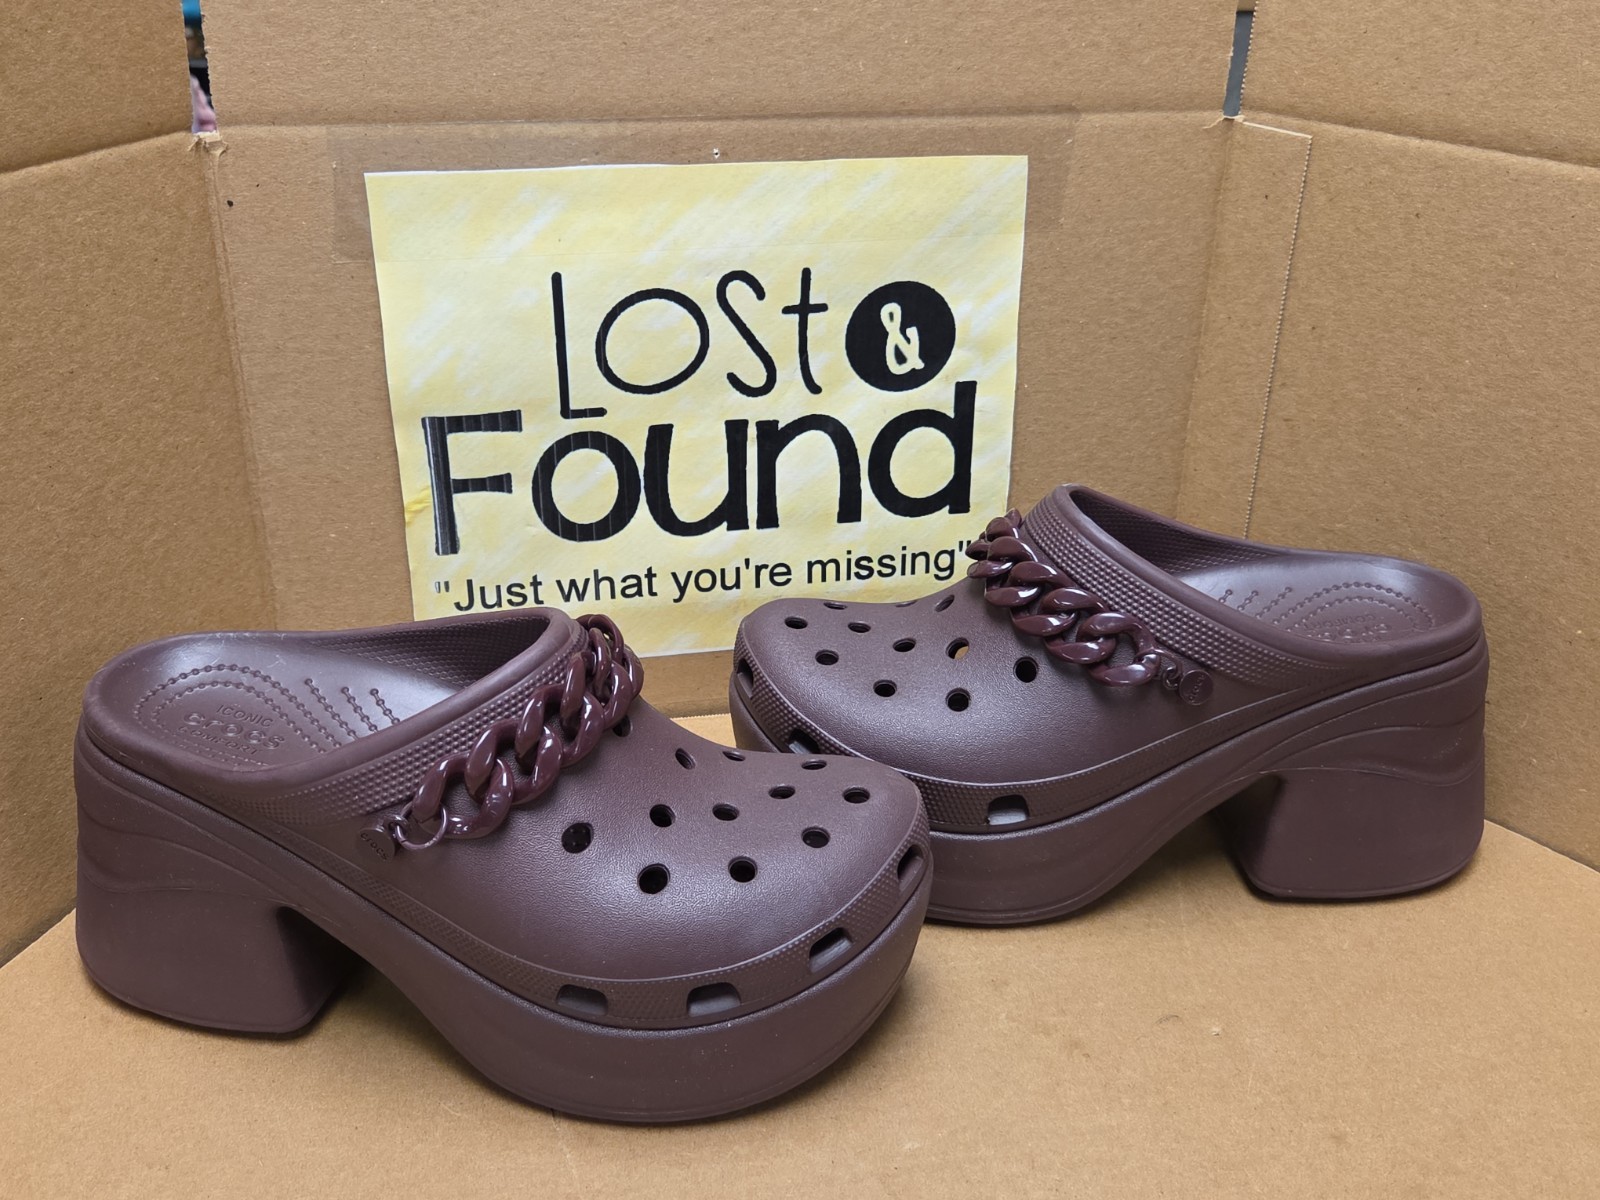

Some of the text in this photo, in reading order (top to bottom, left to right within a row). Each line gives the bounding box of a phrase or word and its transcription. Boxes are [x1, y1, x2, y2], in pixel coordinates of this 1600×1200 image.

[551, 267, 828, 419] Lost
[421, 380, 977, 555] Found
[435, 540, 972, 612] "Just what you're missing"
[183, 711, 286, 750] crocs
[216, 704, 274, 728] ICONIC
[177, 725, 264, 755] COMFORT
[360, 832, 389, 861] crocs
